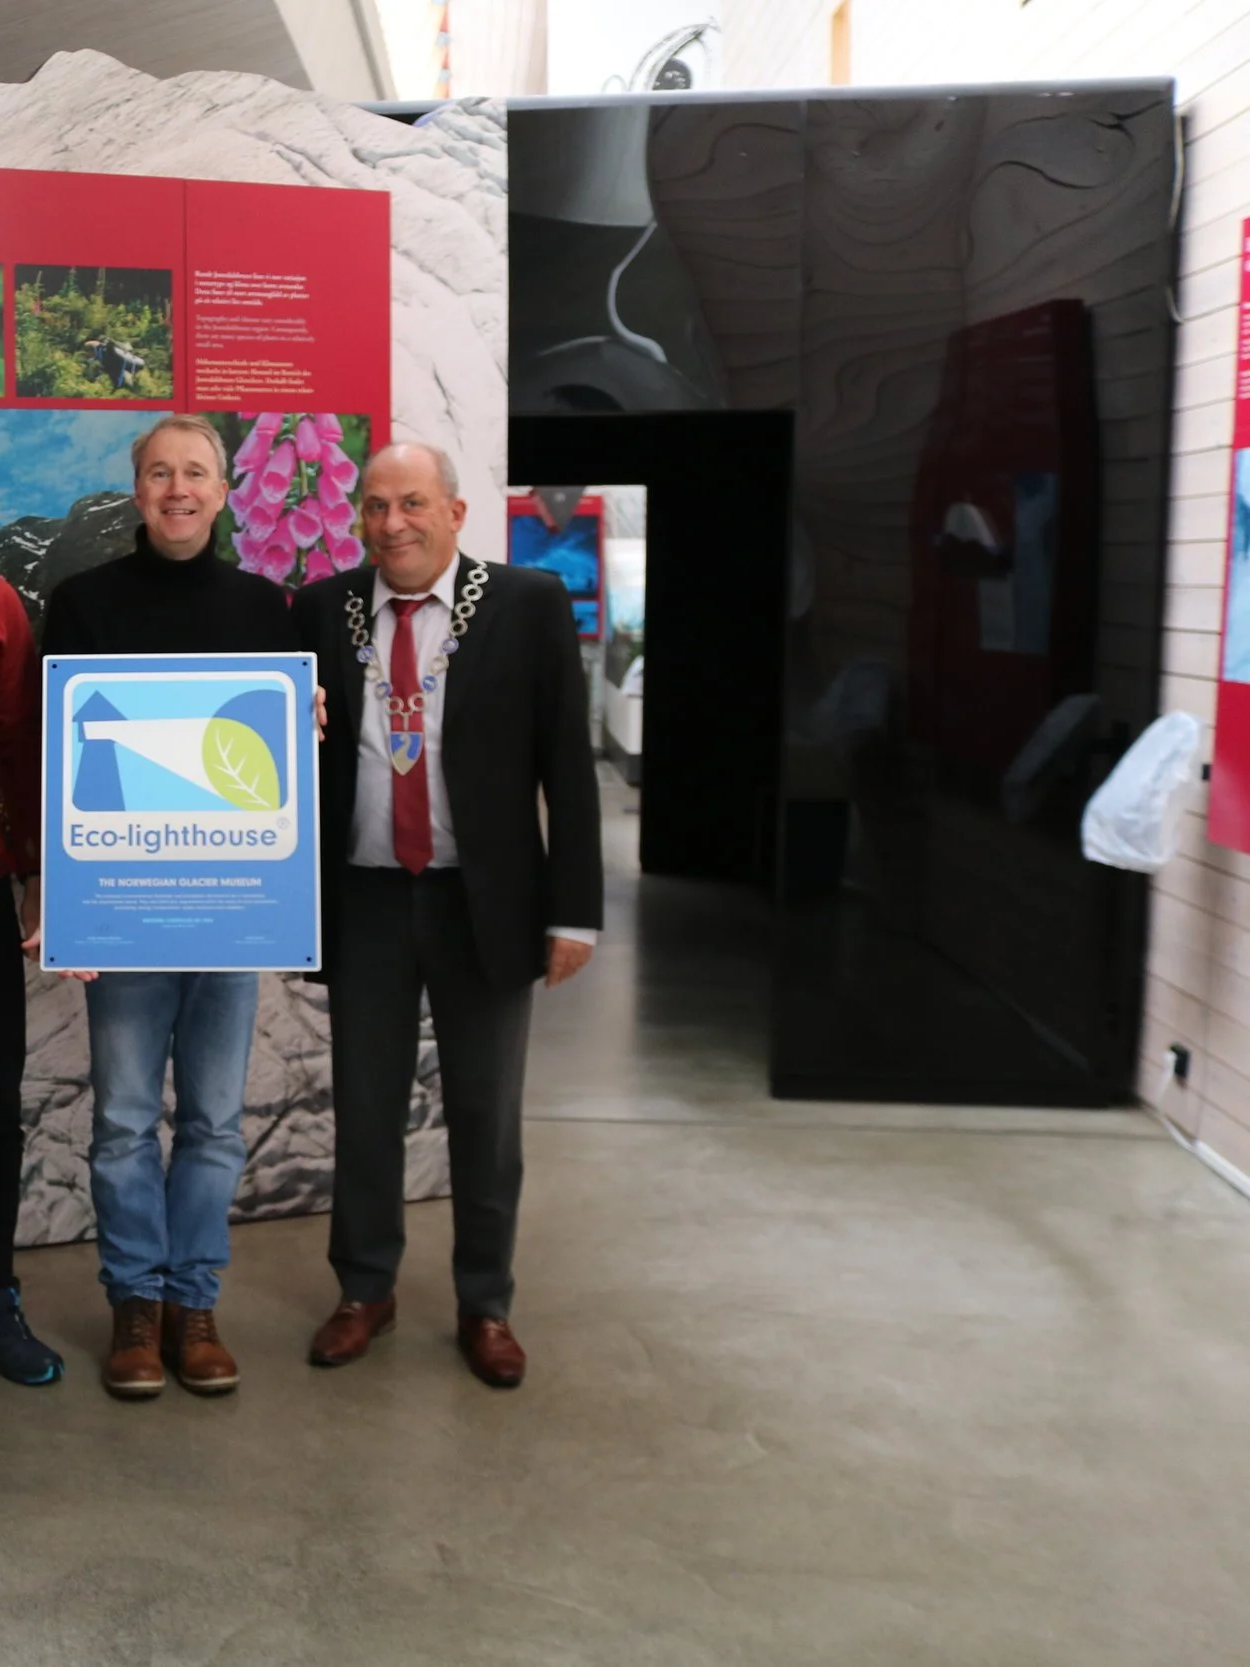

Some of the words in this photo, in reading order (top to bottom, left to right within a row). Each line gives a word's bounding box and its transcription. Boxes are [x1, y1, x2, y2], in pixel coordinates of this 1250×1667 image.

[70, 824, 277, 853] Eco-lighthouse
[98, 878, 115, 887] THE
[118, 878, 176, 887] NORWEGIAN
[179, 878, 218, 887] GLACIER
[220, 878, 261, 886] MUSEUM
